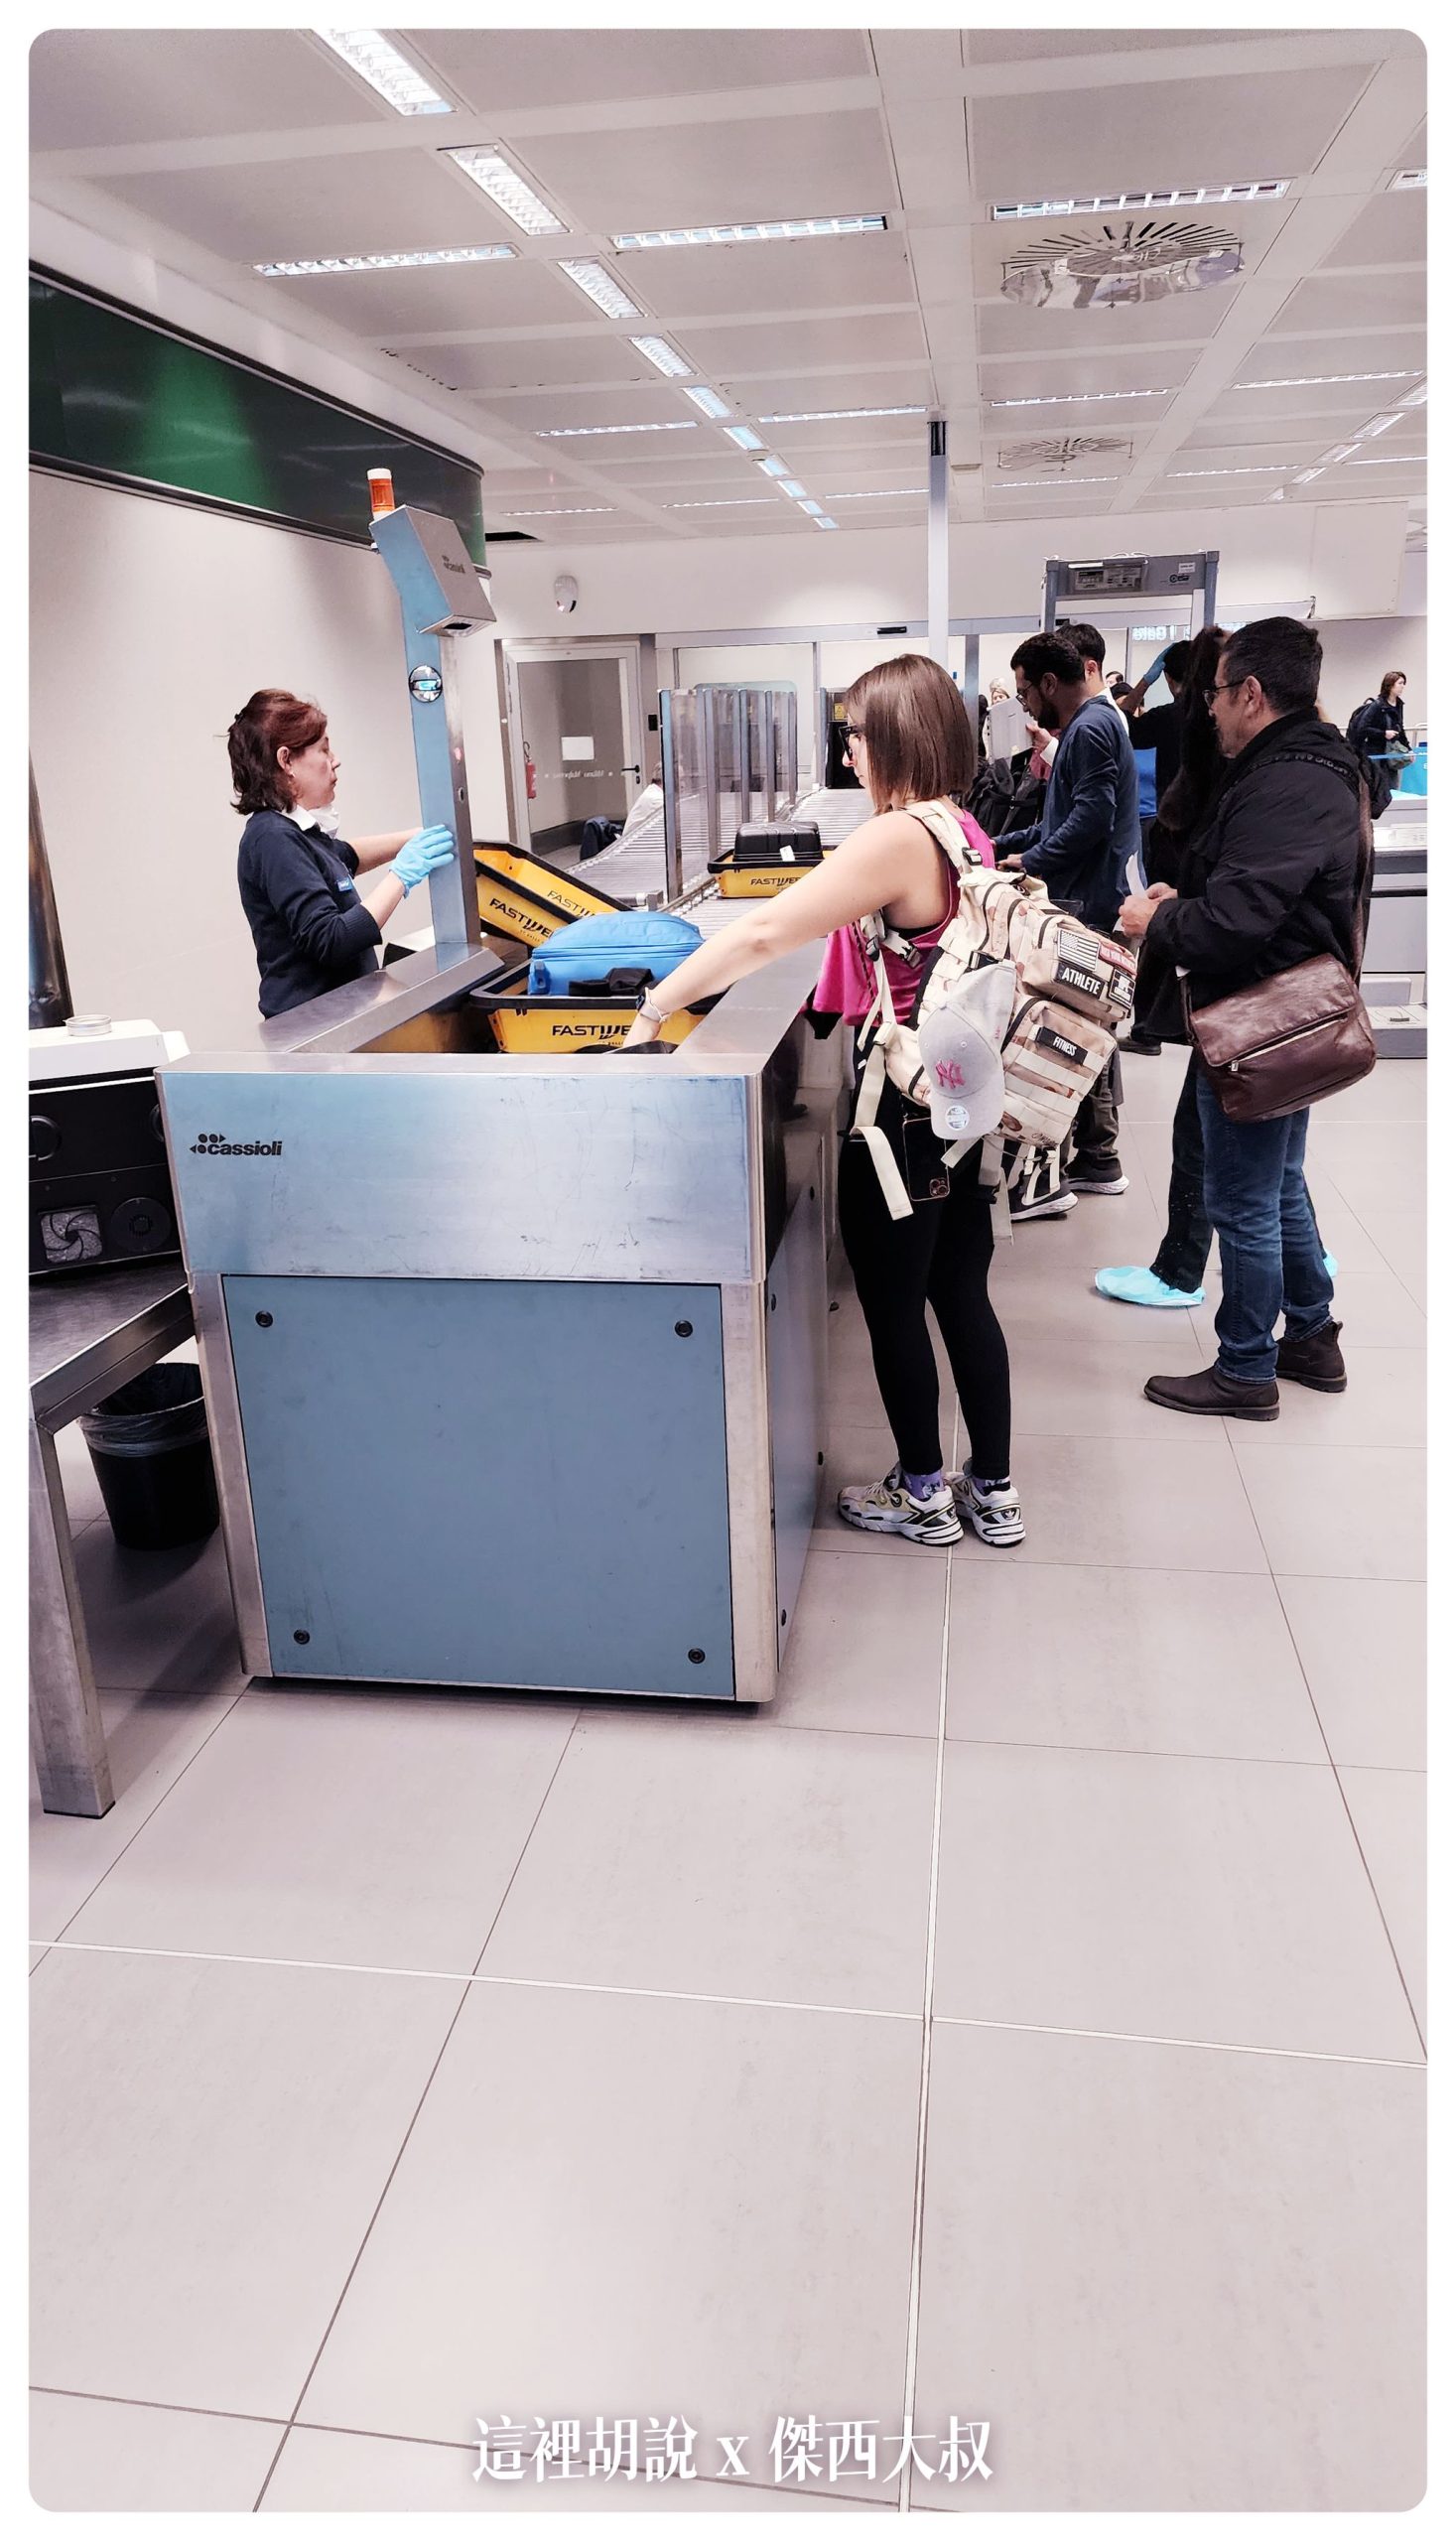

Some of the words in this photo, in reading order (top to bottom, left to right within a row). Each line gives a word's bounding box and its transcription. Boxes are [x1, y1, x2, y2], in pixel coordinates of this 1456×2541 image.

[489, 897, 554, 938] FASTWE
[1061, 967, 1102, 995] ATHLETE
[552, 1024, 632, 1039] FASTWE
[1053, 1036, 1077, 1056] FITNESS
[207, 1140, 283, 1155] cassioli
